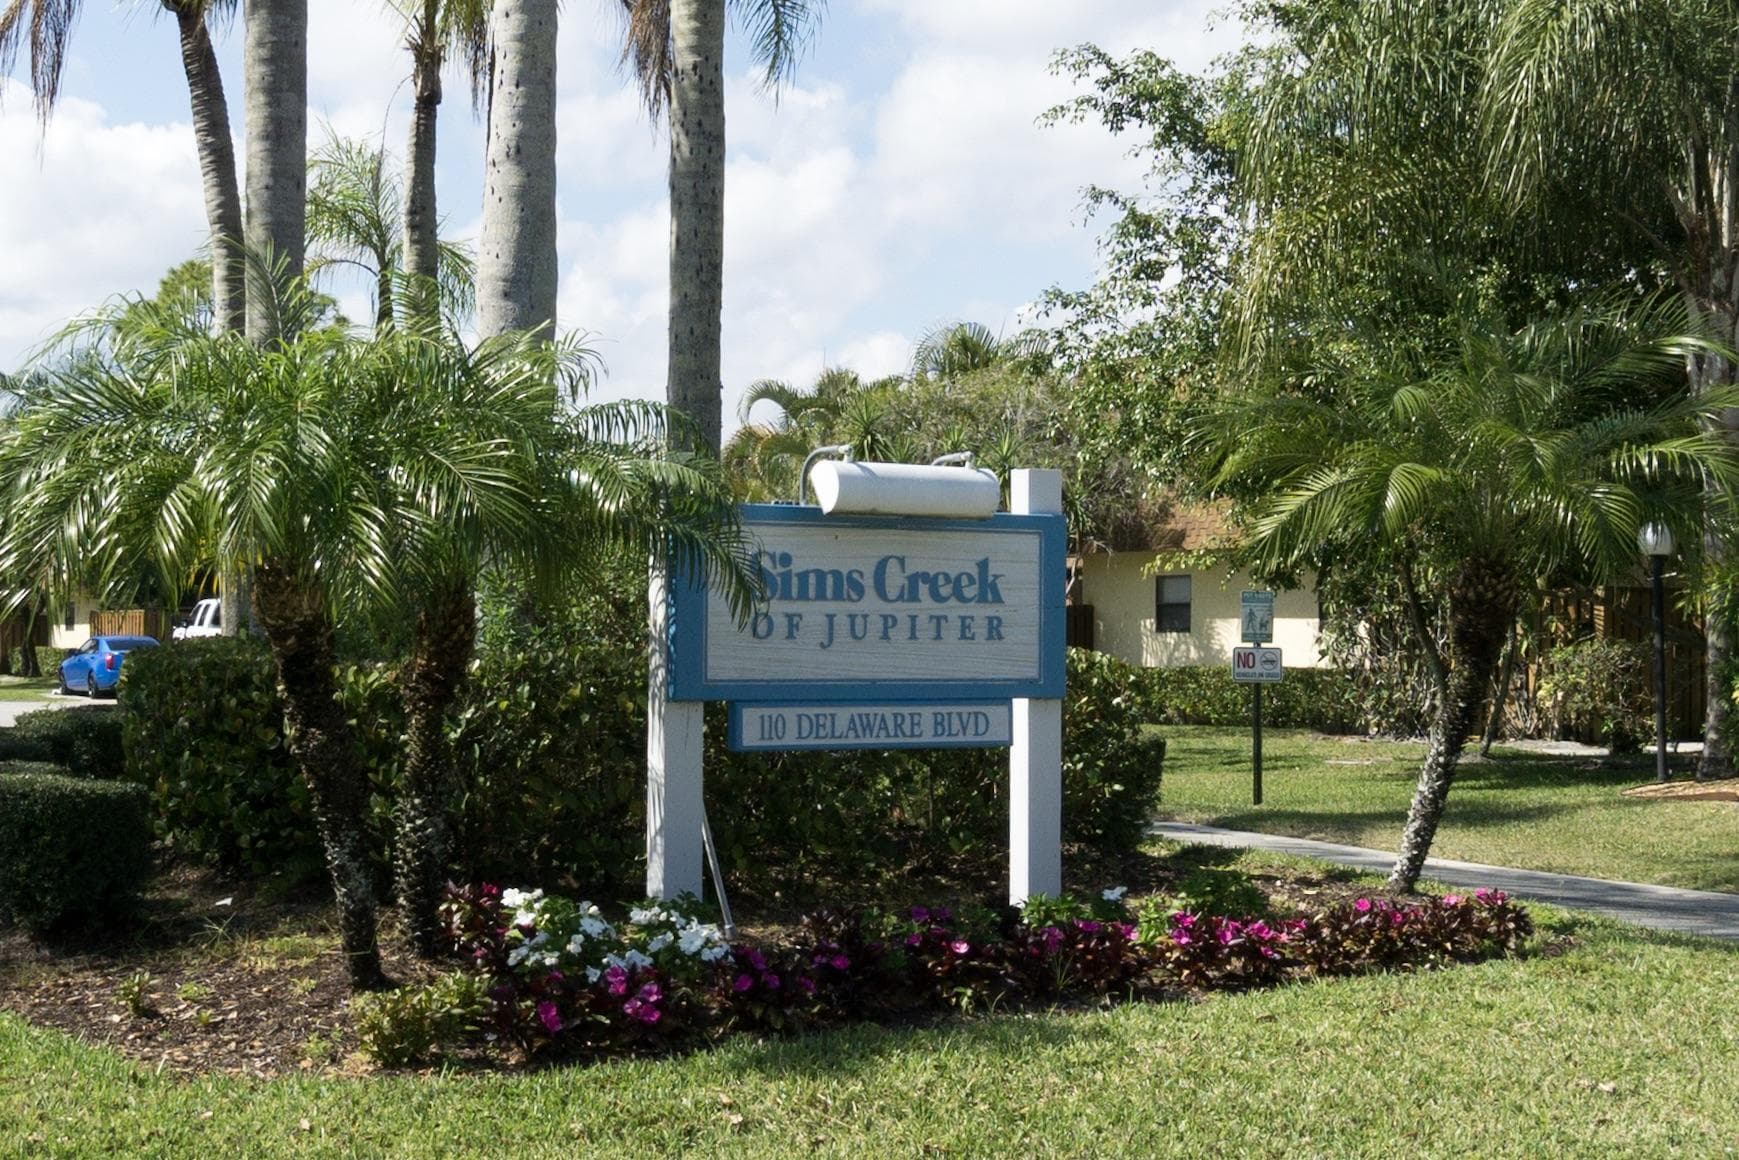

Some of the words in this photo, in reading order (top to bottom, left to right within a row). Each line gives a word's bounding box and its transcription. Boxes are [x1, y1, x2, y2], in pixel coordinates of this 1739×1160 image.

[750, 551, 866, 602] Sims
[873, 555, 1006, 604] Creek
[751, 612, 804, 640] OF
[819, 613, 1006, 649] JUPITER
[1237, 651, 1256, 669] NO
[758, 713, 787, 741] 110
[795, 711, 924, 740] DELAWARE
[932, 711, 991, 738] BLVD
